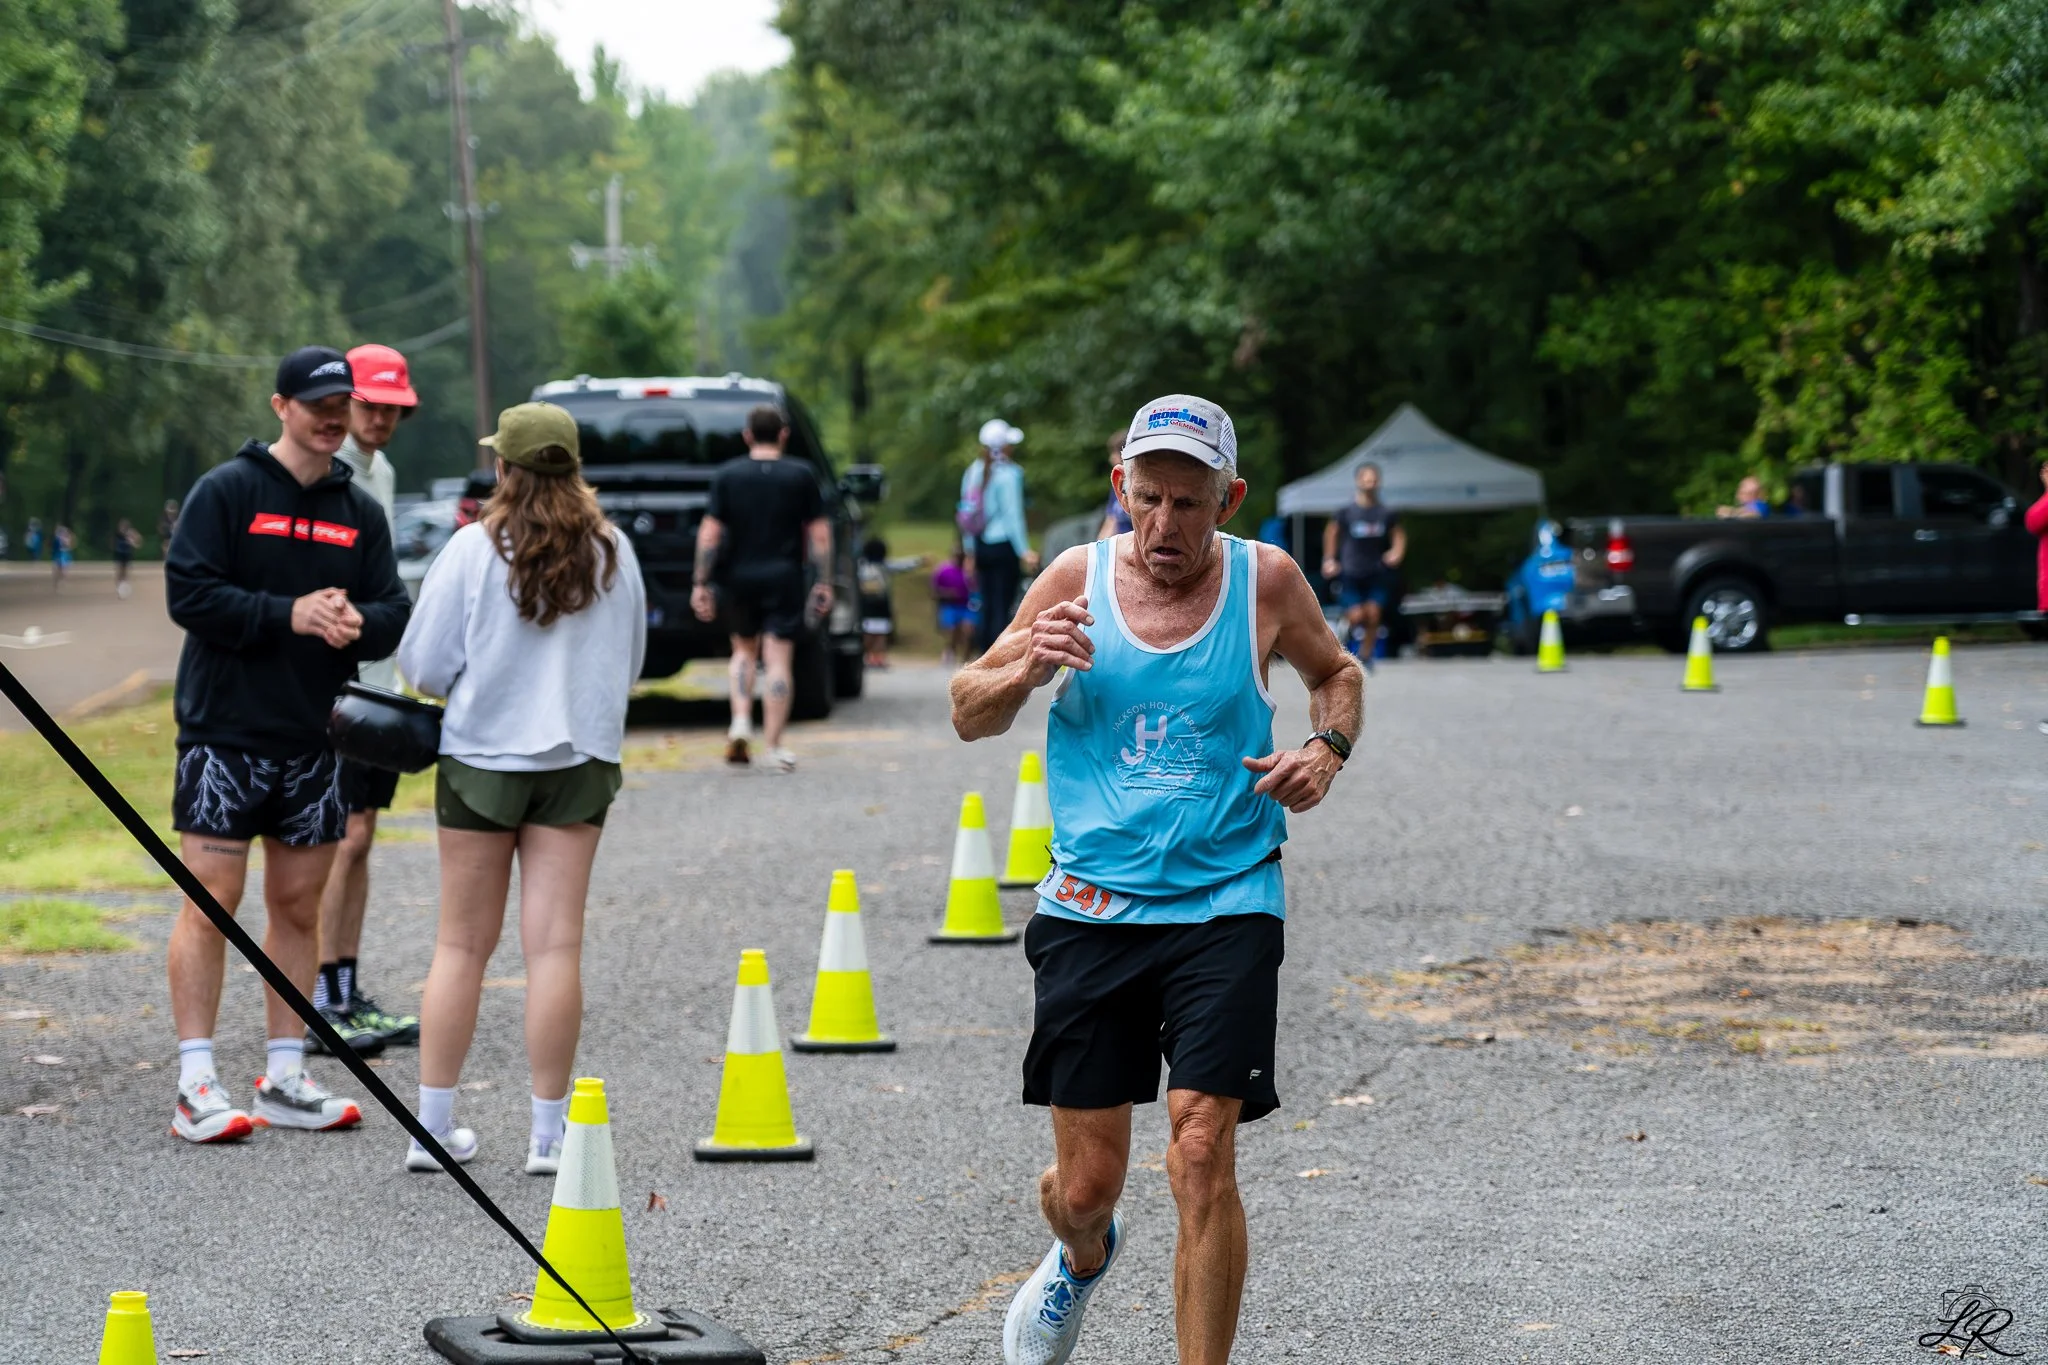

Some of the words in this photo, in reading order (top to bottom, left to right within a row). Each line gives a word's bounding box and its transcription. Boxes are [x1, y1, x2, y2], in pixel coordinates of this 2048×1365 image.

[1147, 418, 1171, 431] 70.3
[1172, 421, 1205, 436] MEMPHIS
[1148, 408, 1208, 429] IRONMAN
[1112, 702, 1147, 733] JACKSON
[1149, 701, 1176, 713] HOLE
[1055, 874, 1113, 917] 541
